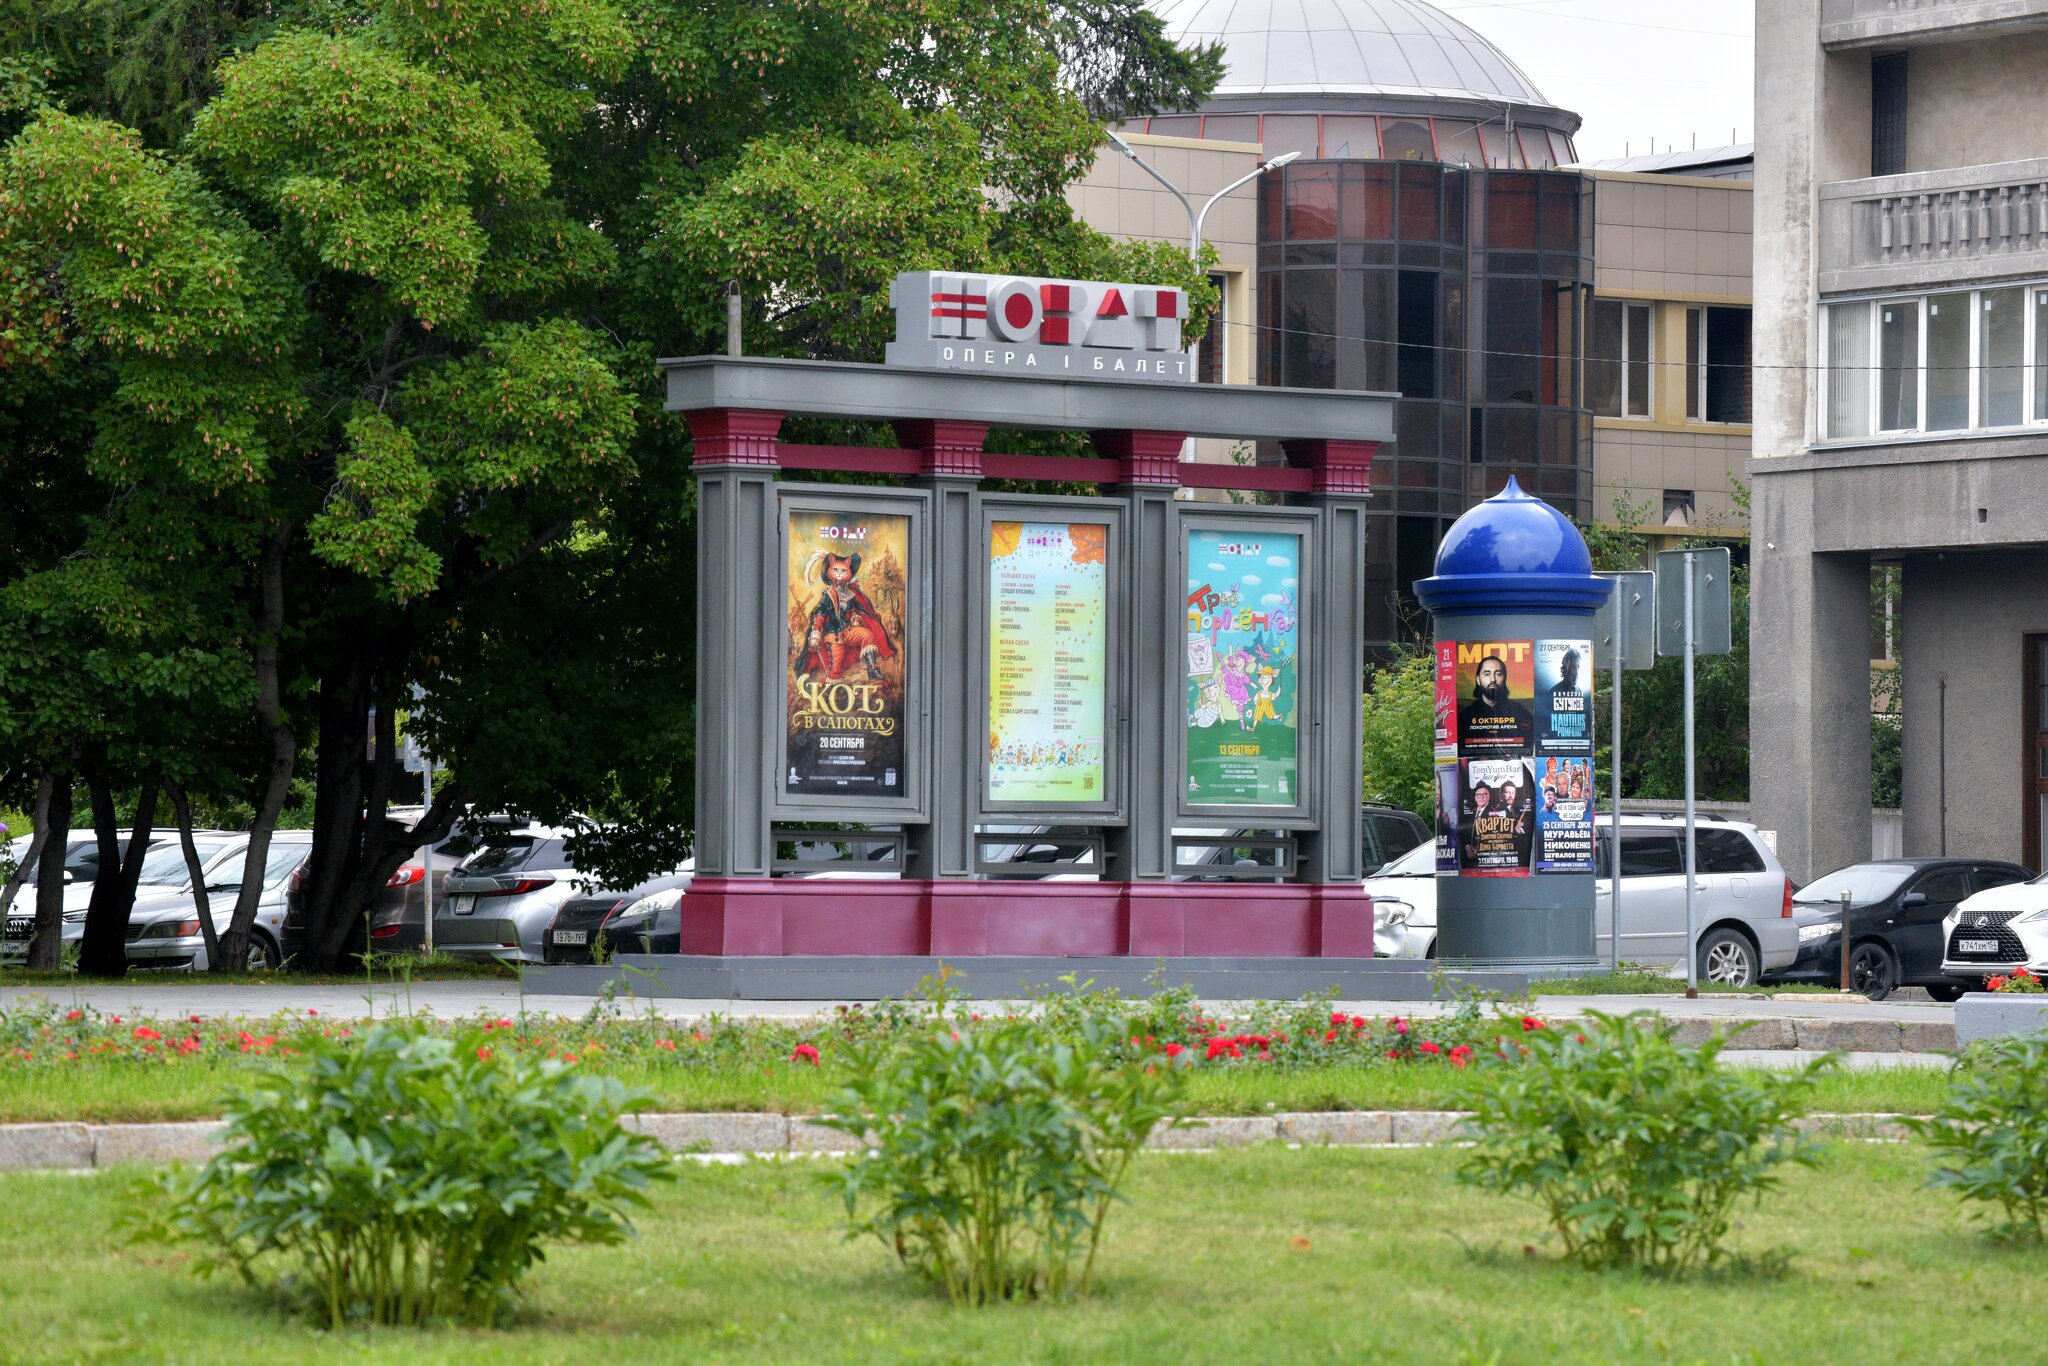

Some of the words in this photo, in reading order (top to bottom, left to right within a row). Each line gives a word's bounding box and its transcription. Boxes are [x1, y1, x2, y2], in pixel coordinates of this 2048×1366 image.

[931, 276, 1188, 350] НОВАТ
[943, 347, 1037, 366] ОПЕРА
[1093, 357, 1186, 376] БАЛЕТ
[1458, 643, 1530, 664] МОТ
[1539, 644, 1547, 652] 27
[1547, 644, 1571, 652] СЕНТЯБРЯ
[1443, 648, 1450, 661] 21
[797, 674, 885, 716] КОТ
[1553, 697, 1584, 711] БУТУСОВ
[804, 715, 814, 729] В
[817, 716, 895, 735] САПОГАХ
[1478, 716, 1515, 724] ОКТЯБРЯ
[1551, 713, 1586, 731] NAUTILUS
[819, 738, 829, 750] 20
[830, 738, 864, 750] СЕНТЯБРЯ
[1218, 744, 1227, 756] 13
[1228, 744, 1260, 756] СЕНТЯБРЯ
[1542, 821, 1550, 829] 25
[1550, 821, 1576, 829] СЕНТЯБРЯ
[1543, 829, 1591, 839] МУРАВЬЁВА
[1544, 841, 1591, 850] НИКОНЕНКО
[556, 931, 572, 943] 1976
